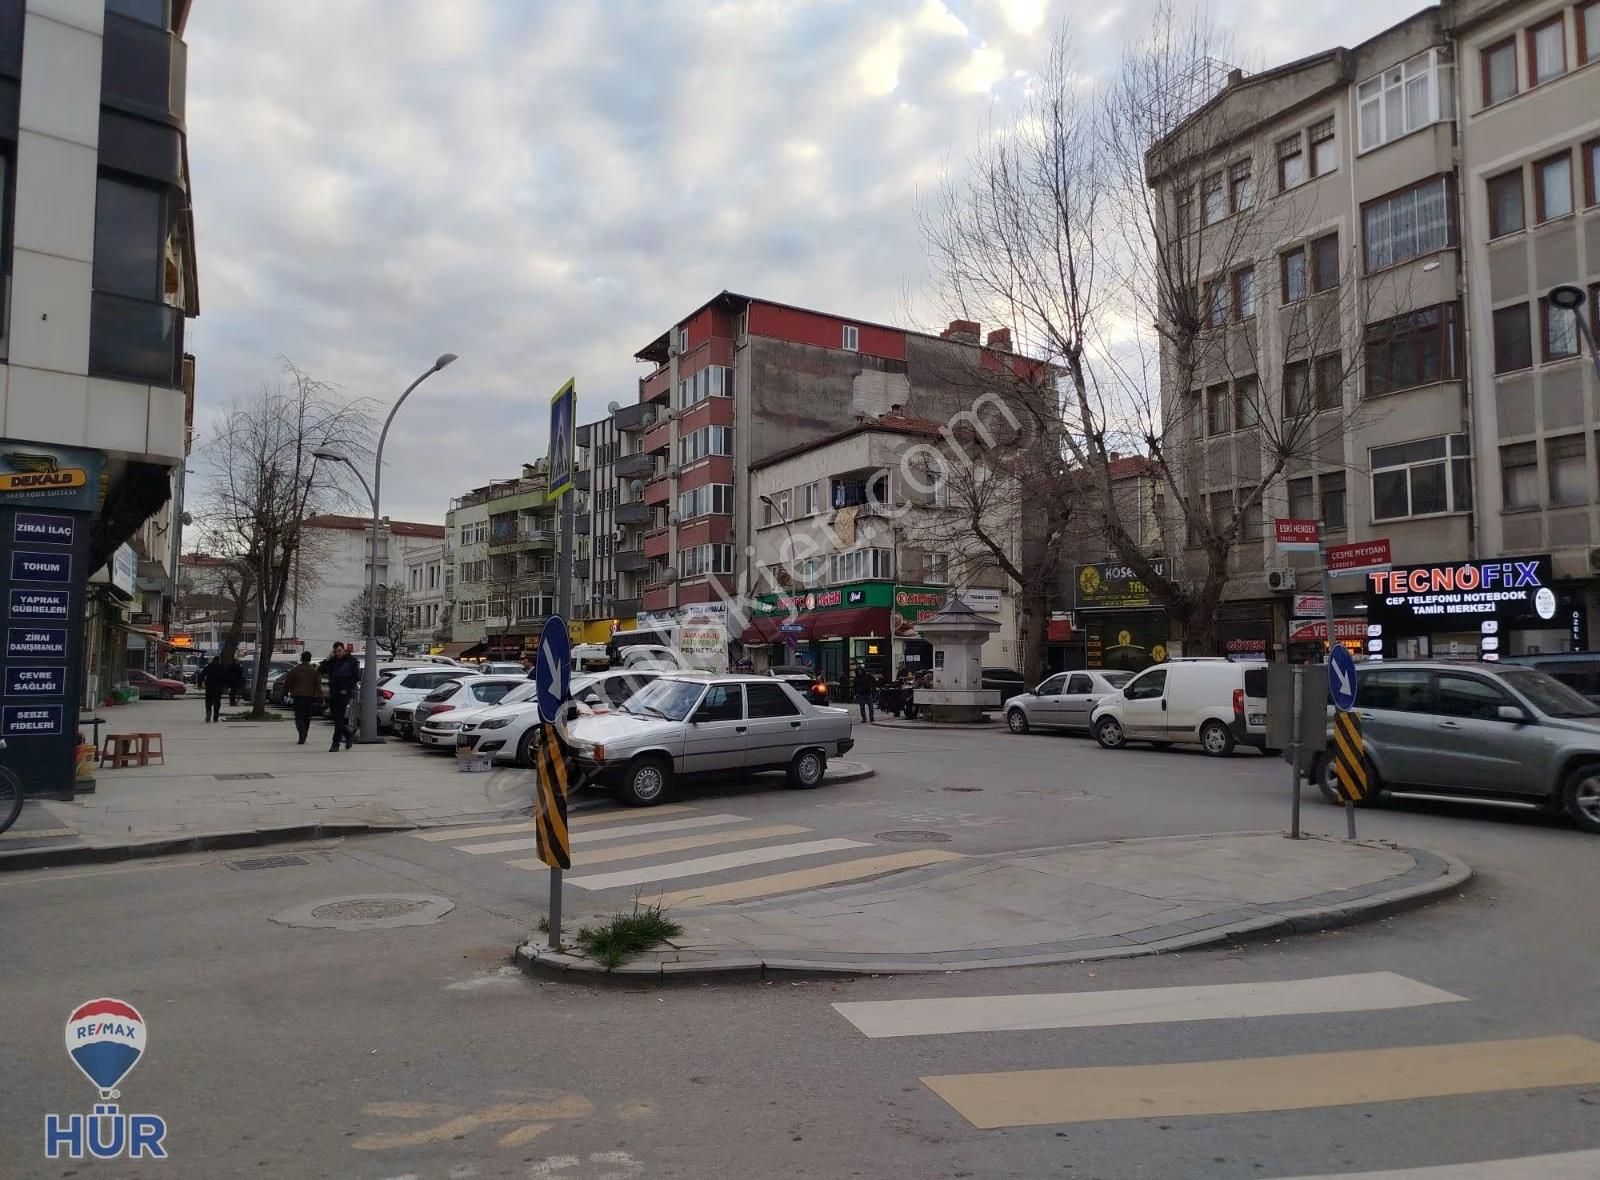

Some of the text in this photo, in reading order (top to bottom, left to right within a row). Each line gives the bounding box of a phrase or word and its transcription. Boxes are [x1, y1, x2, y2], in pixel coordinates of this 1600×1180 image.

[11, 473, 73, 488] DEKALB
[16, 522, 72, 536] ZİRAİ İLAÇ
[1279, 523, 1316, 533] ESKİ HENDEK
[1331, 551, 1354, 561] ÇEŞME
[1354, 544, 1386, 557] MEYDANI
[23, 562, 60, 572] TOHUM
[20, 596, 60, 604] YAPRAK
[1386, 591, 1527, 605] CEP TELEFONU NOTEBOOK
[12, 604, 66, 614] GÜBRELERİ
[1412, 603, 1496, 615] TAMİR MERKEZİ
[1313, 622, 1368, 637] VEERİNER
[1572, 610, 1580, 640] ÖZEL
[25, 633, 50, 642] ZİRAİ
[10, 643, 63, 652] DANIŞMANLIK
[1226, 638, 1266, 650] GÜVEN
[19, 671, 53, 681] ÇEVRE
[14, 682, 56, 691] SAĞLIĞI
[17, 711, 49, 719] SEBZE
[10, 721, 54, 731] FİDELERİ
